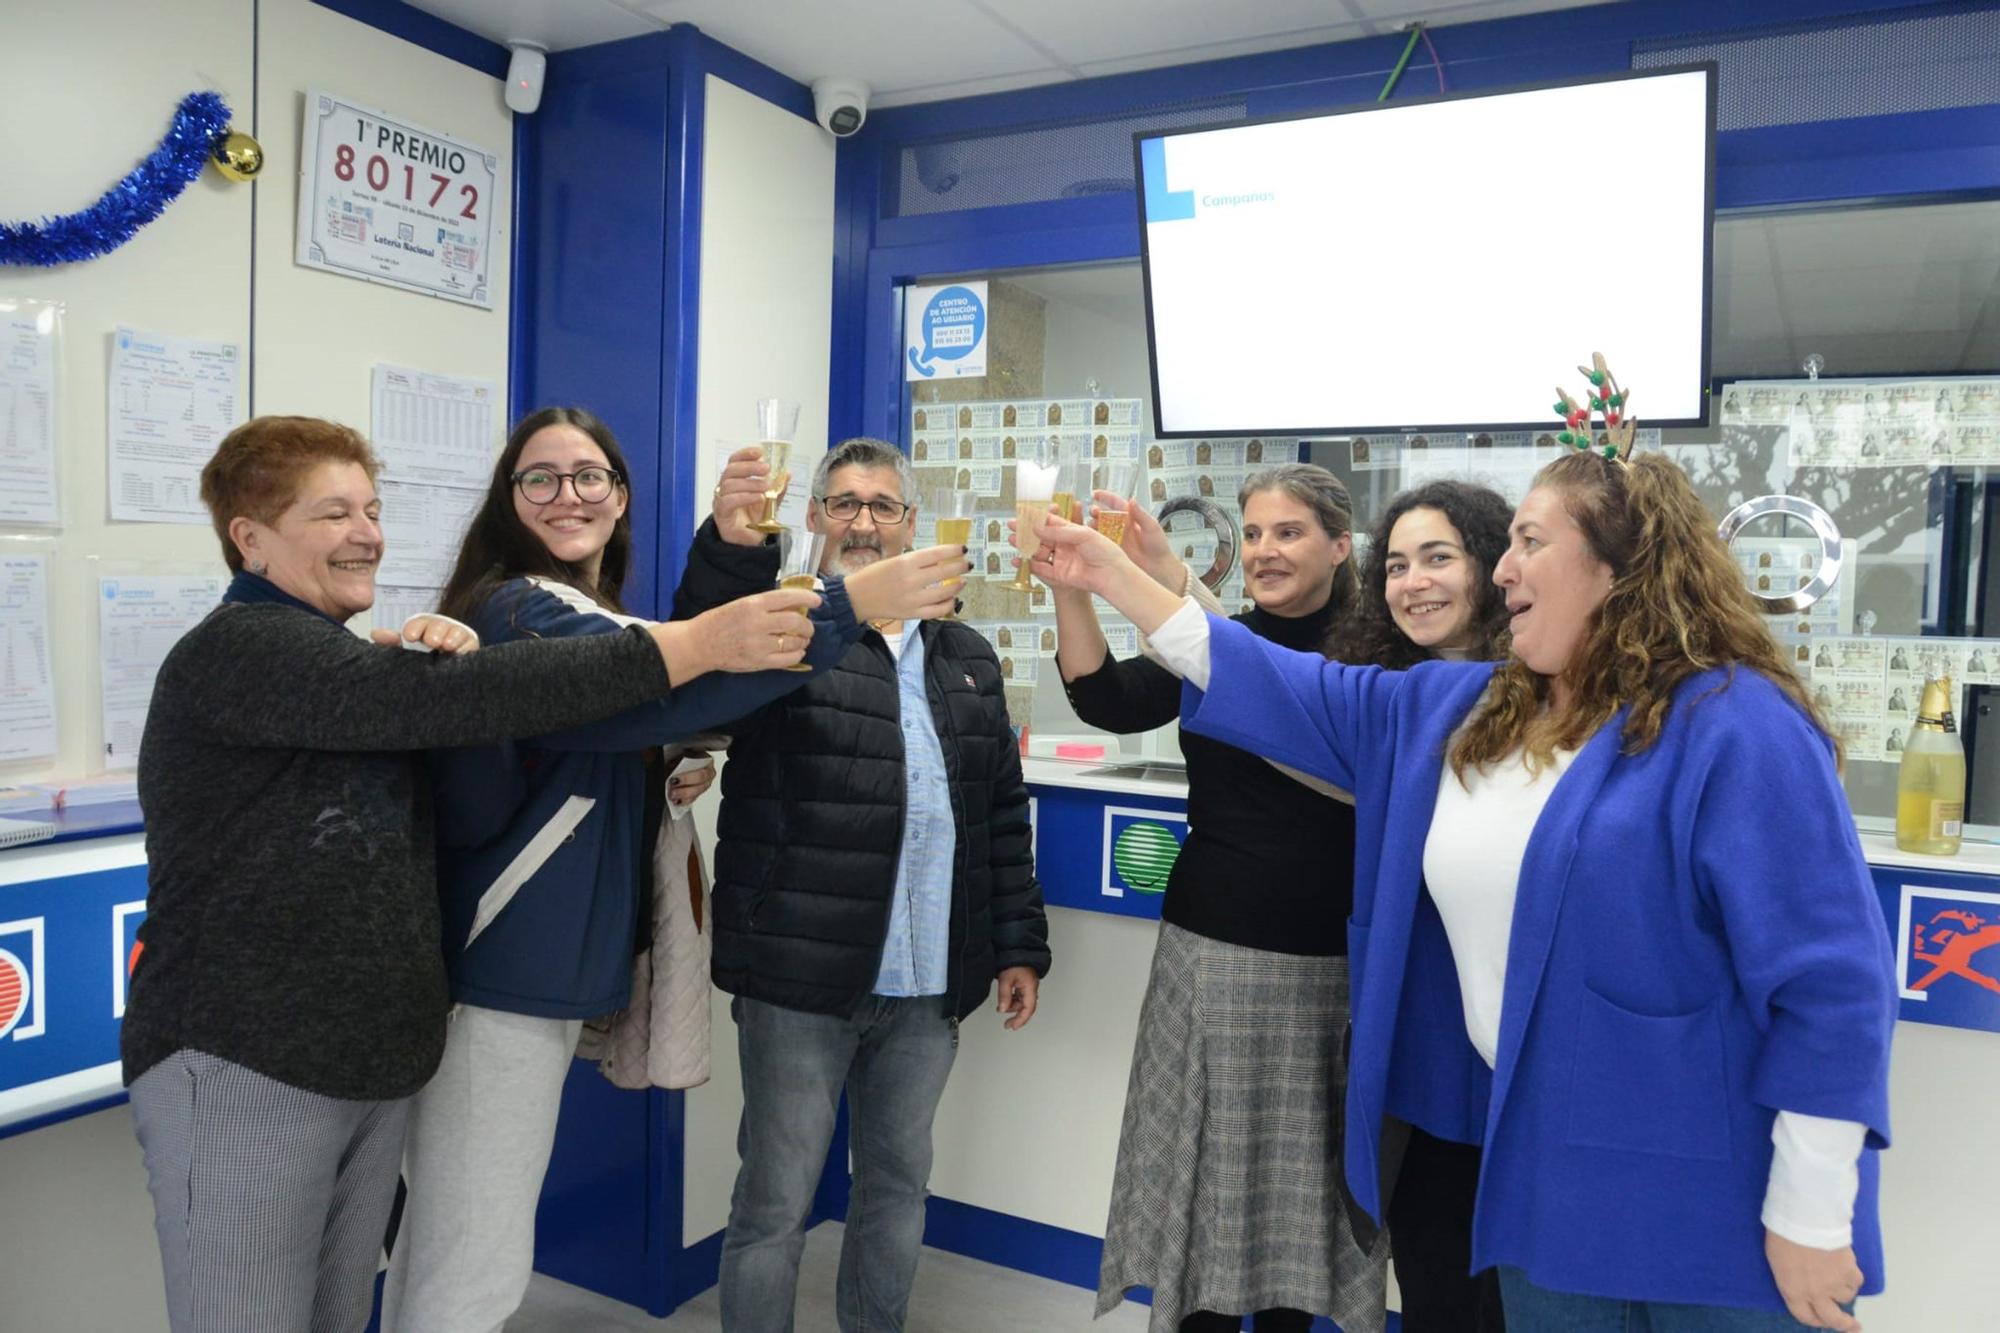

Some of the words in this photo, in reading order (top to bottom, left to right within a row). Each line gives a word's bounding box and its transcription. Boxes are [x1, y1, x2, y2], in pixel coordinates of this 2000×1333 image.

[377, 126, 465, 174] PREMIO
[335, 144, 478, 219] 80172
[403, 241, 435, 257] Nacional
[939, 298, 968, 308] CENTRO
[929, 309, 940, 317] DE
